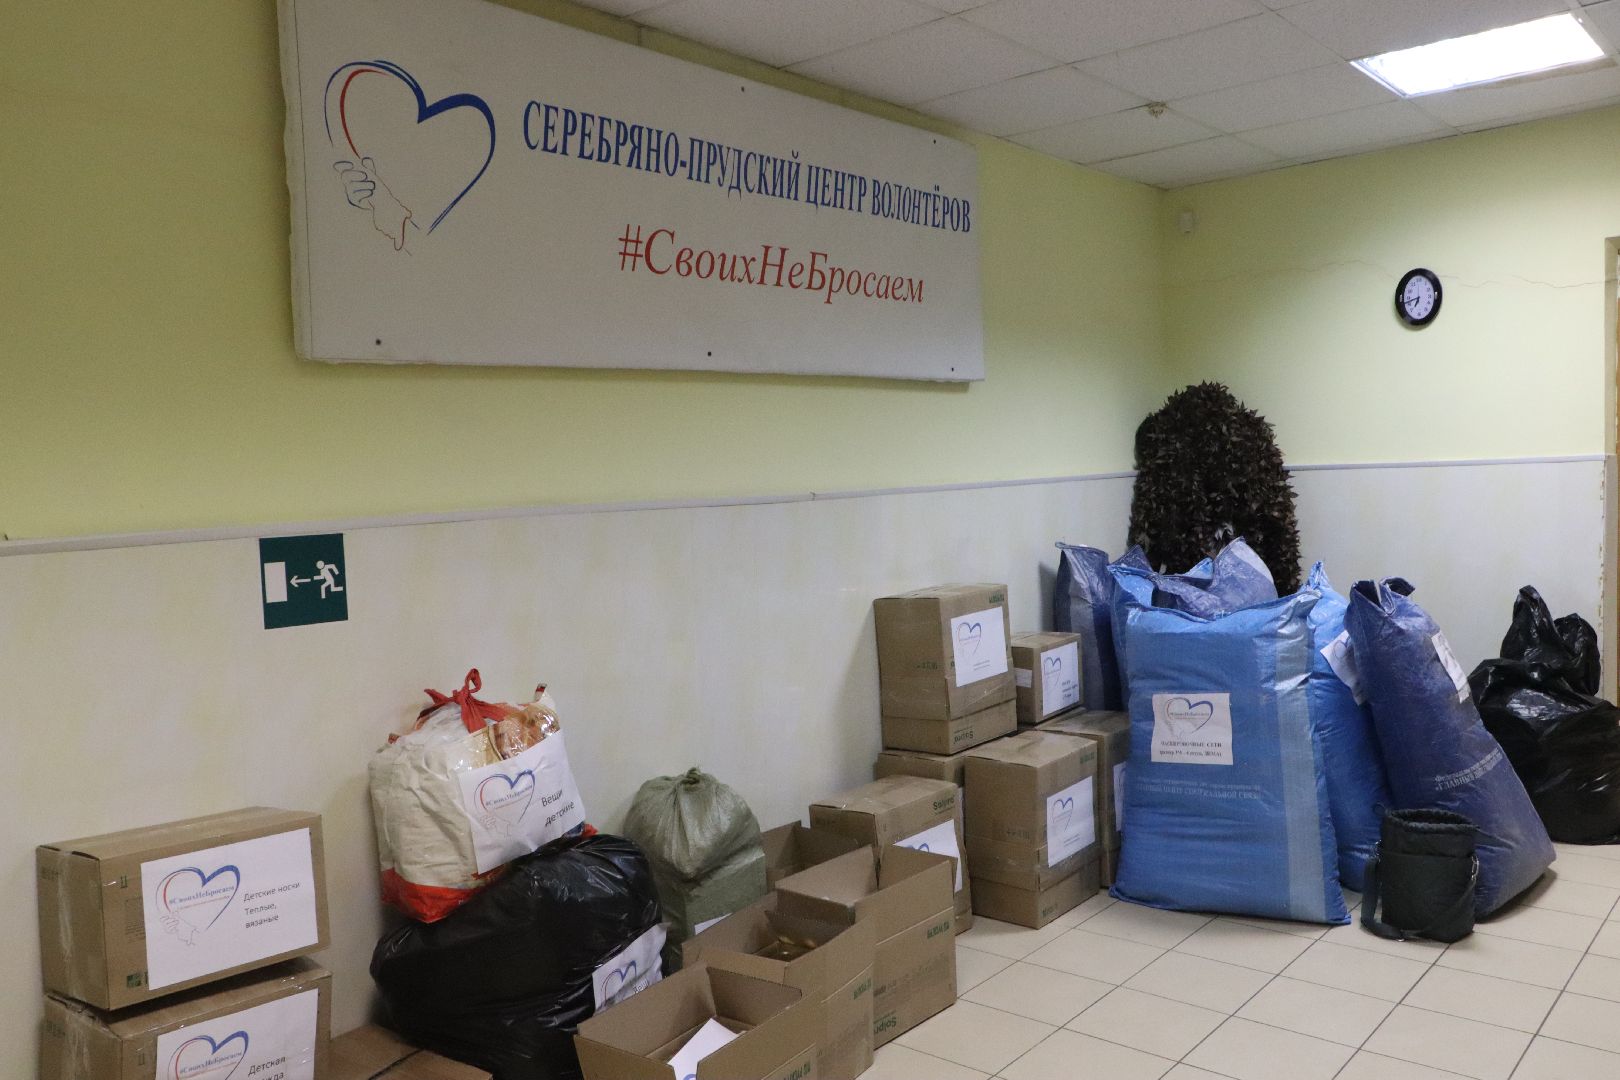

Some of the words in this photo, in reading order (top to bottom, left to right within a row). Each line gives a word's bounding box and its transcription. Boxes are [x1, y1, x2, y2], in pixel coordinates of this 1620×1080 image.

[523, 100, 801, 201] СЕРЕБРЯНО-ПРУДСКИЙ
[805, 163, 868, 214] ЦЕНТР
[871, 179, 972, 233] ВОЛОНТЁРОВ
[618, 223, 925, 305] #СвоихНеБросаем
[541, 789, 563, 807] Вещи
[545, 801, 575, 827] детские
[243, 887, 276, 902] Детские
[277, 881, 301, 895] носки
[245, 914, 280, 929] вязаные
[248, 1056, 286, 1077] Детская
